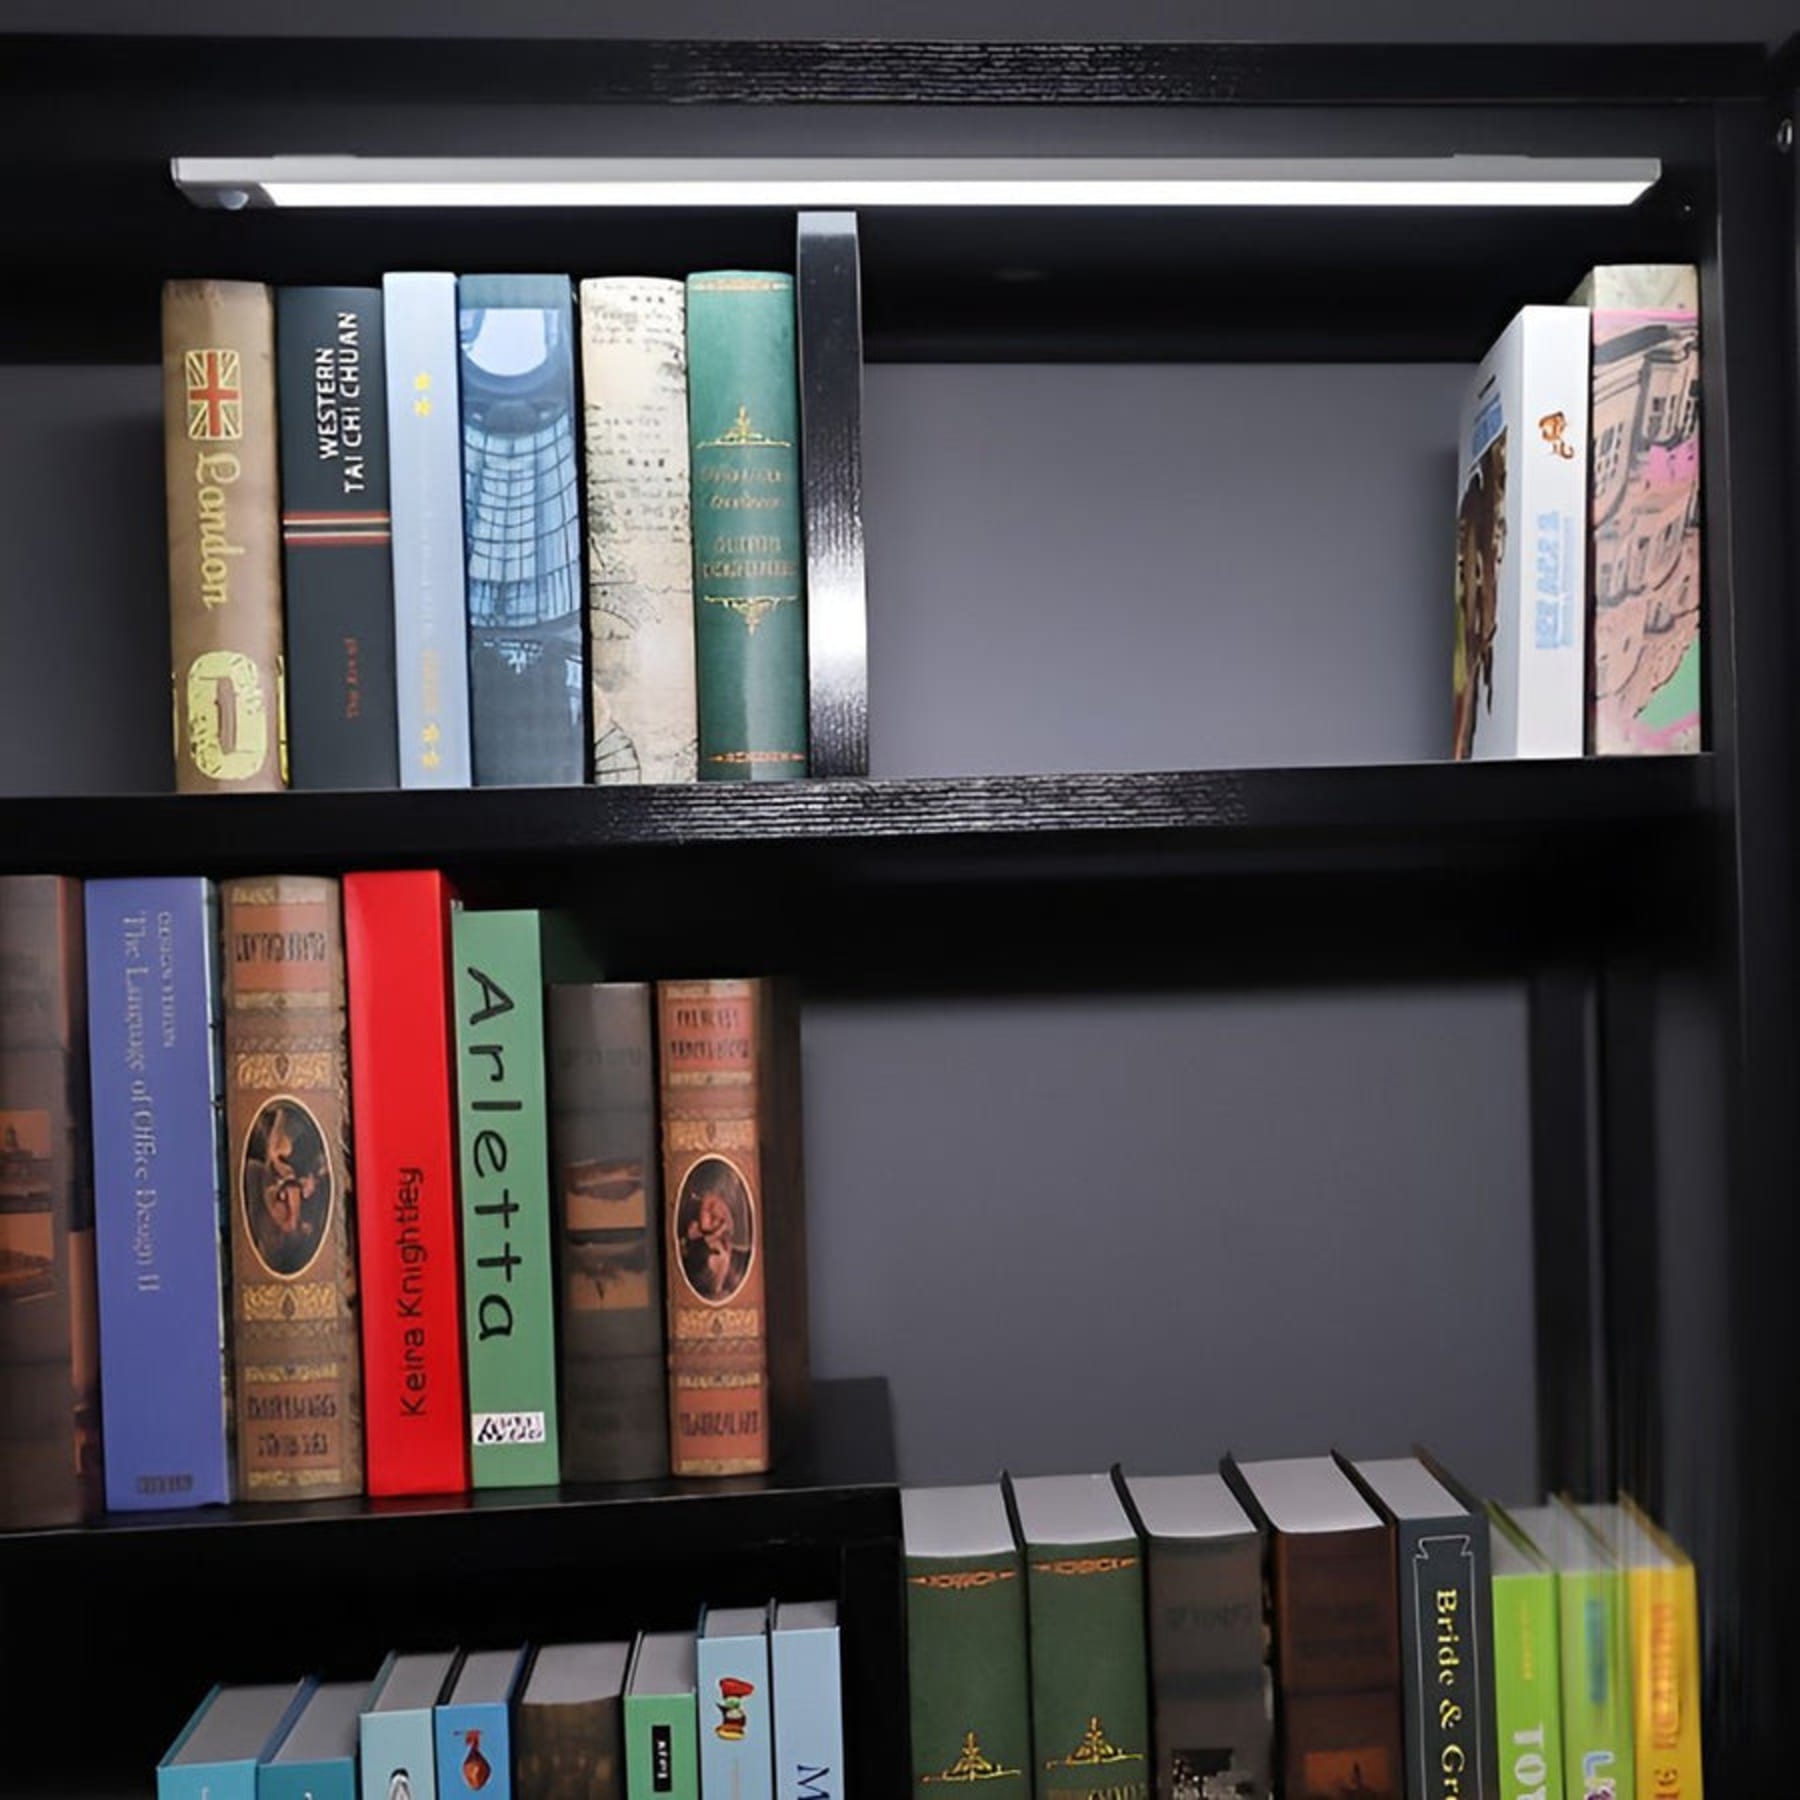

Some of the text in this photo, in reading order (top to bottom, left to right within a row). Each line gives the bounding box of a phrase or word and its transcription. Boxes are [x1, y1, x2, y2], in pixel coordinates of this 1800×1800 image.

[315, 347, 339, 460] WESTERN
[338, 312, 365, 494] TAI CHI CHUAN
[195, 451, 246, 611] London
[121, 911, 149, 959] The
[121, 966, 151, 1071] Language
[128, 1080, 154, 1104] of
[131, 1109, 159, 1179] Office
[467, 965, 523, 1342] Arletta
[398, 1327, 427, 1418] Keira
[1436, 1588, 1461, 1687] Bride
[1438, 1698, 1463, 1730] &
